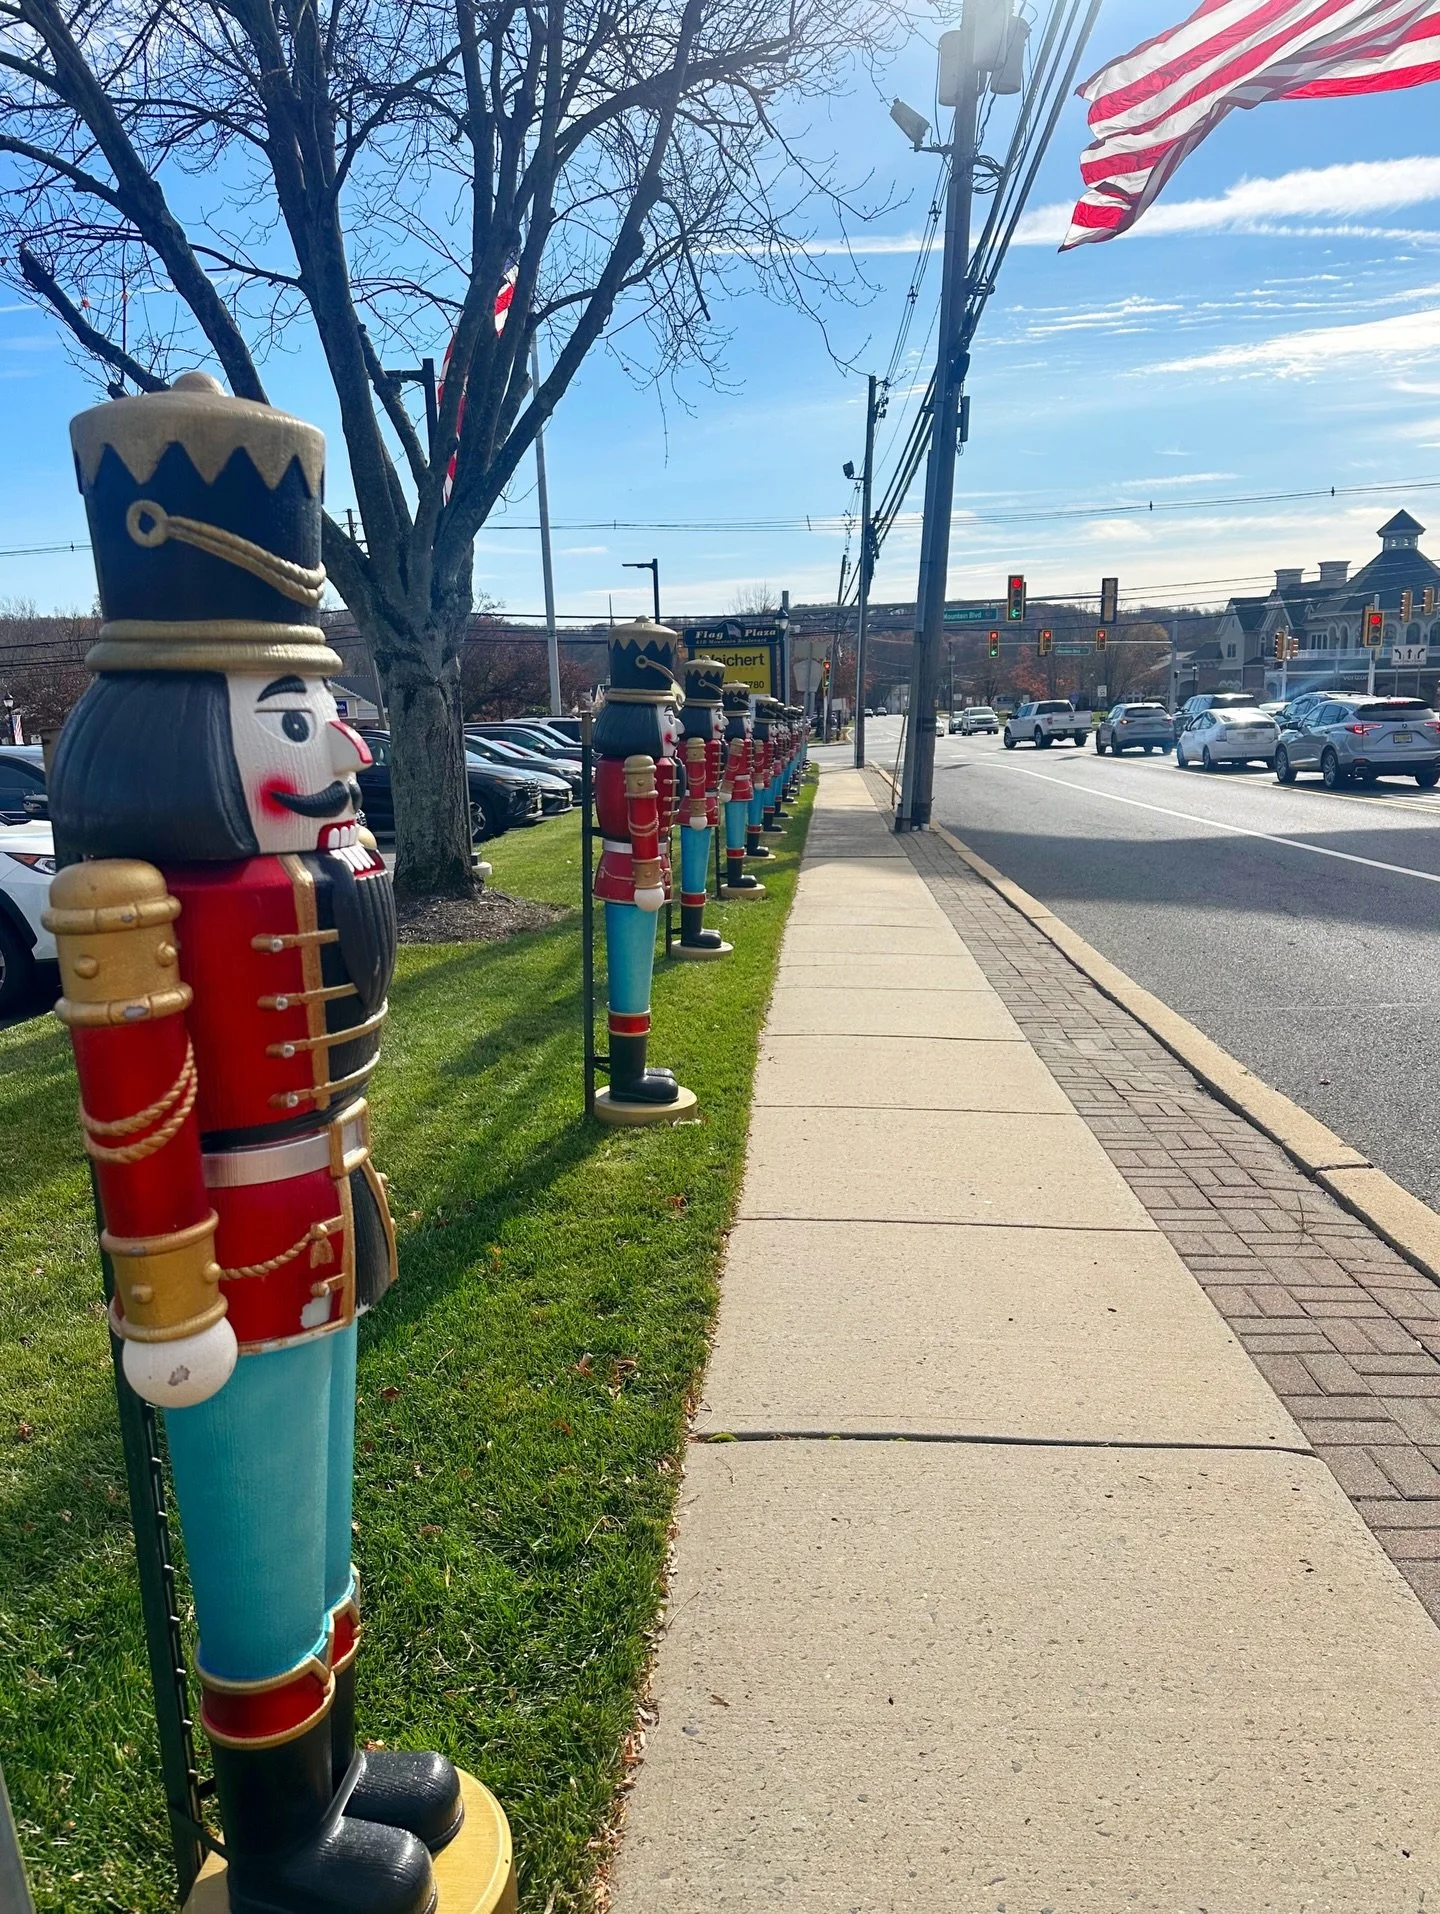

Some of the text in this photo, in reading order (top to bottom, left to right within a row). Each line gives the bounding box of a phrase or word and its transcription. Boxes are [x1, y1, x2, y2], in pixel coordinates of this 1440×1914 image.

[695, 628, 776, 639] Flag Plaza
[699, 653, 765, 666] eichert
